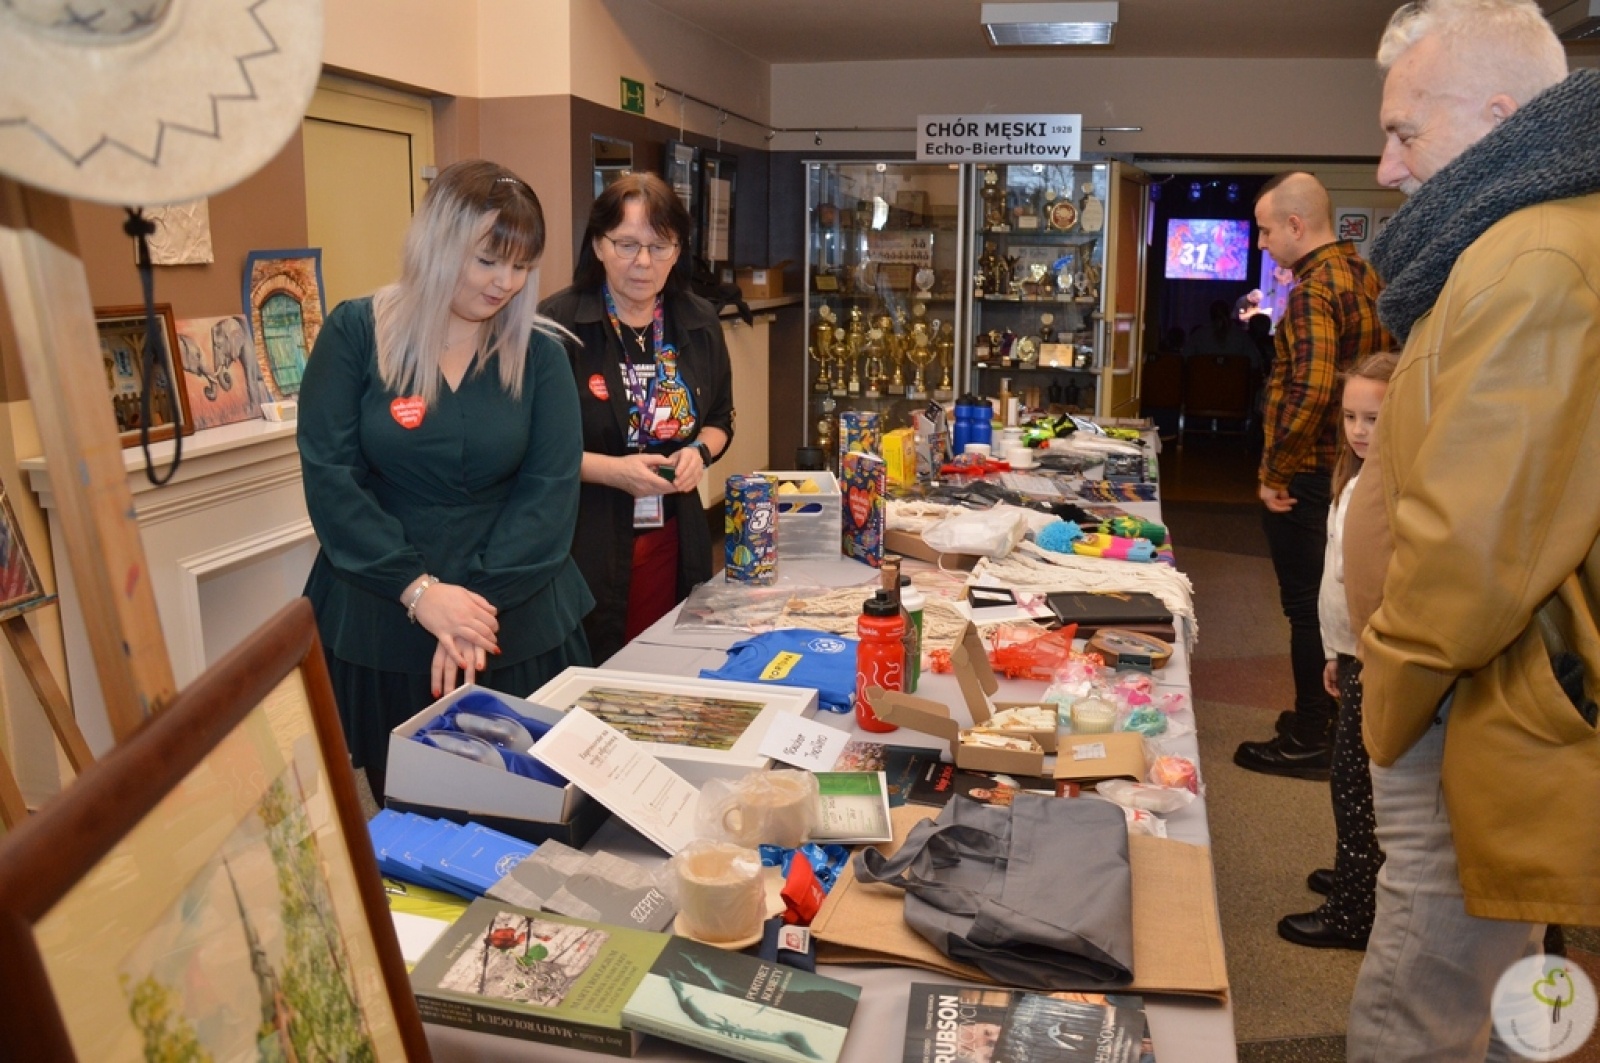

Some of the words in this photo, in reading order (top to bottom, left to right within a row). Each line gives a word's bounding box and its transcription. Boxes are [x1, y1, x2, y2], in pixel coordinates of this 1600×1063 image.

[925, 117, 979, 137] CHÓR
[985, 122, 1047, 140] MĘSKI
[1051, 126, 1073, 134] 1928
[925, 142, 1071, 158] Echo-Biertułtowy
[630, 887, 665, 924] SZEPTY
